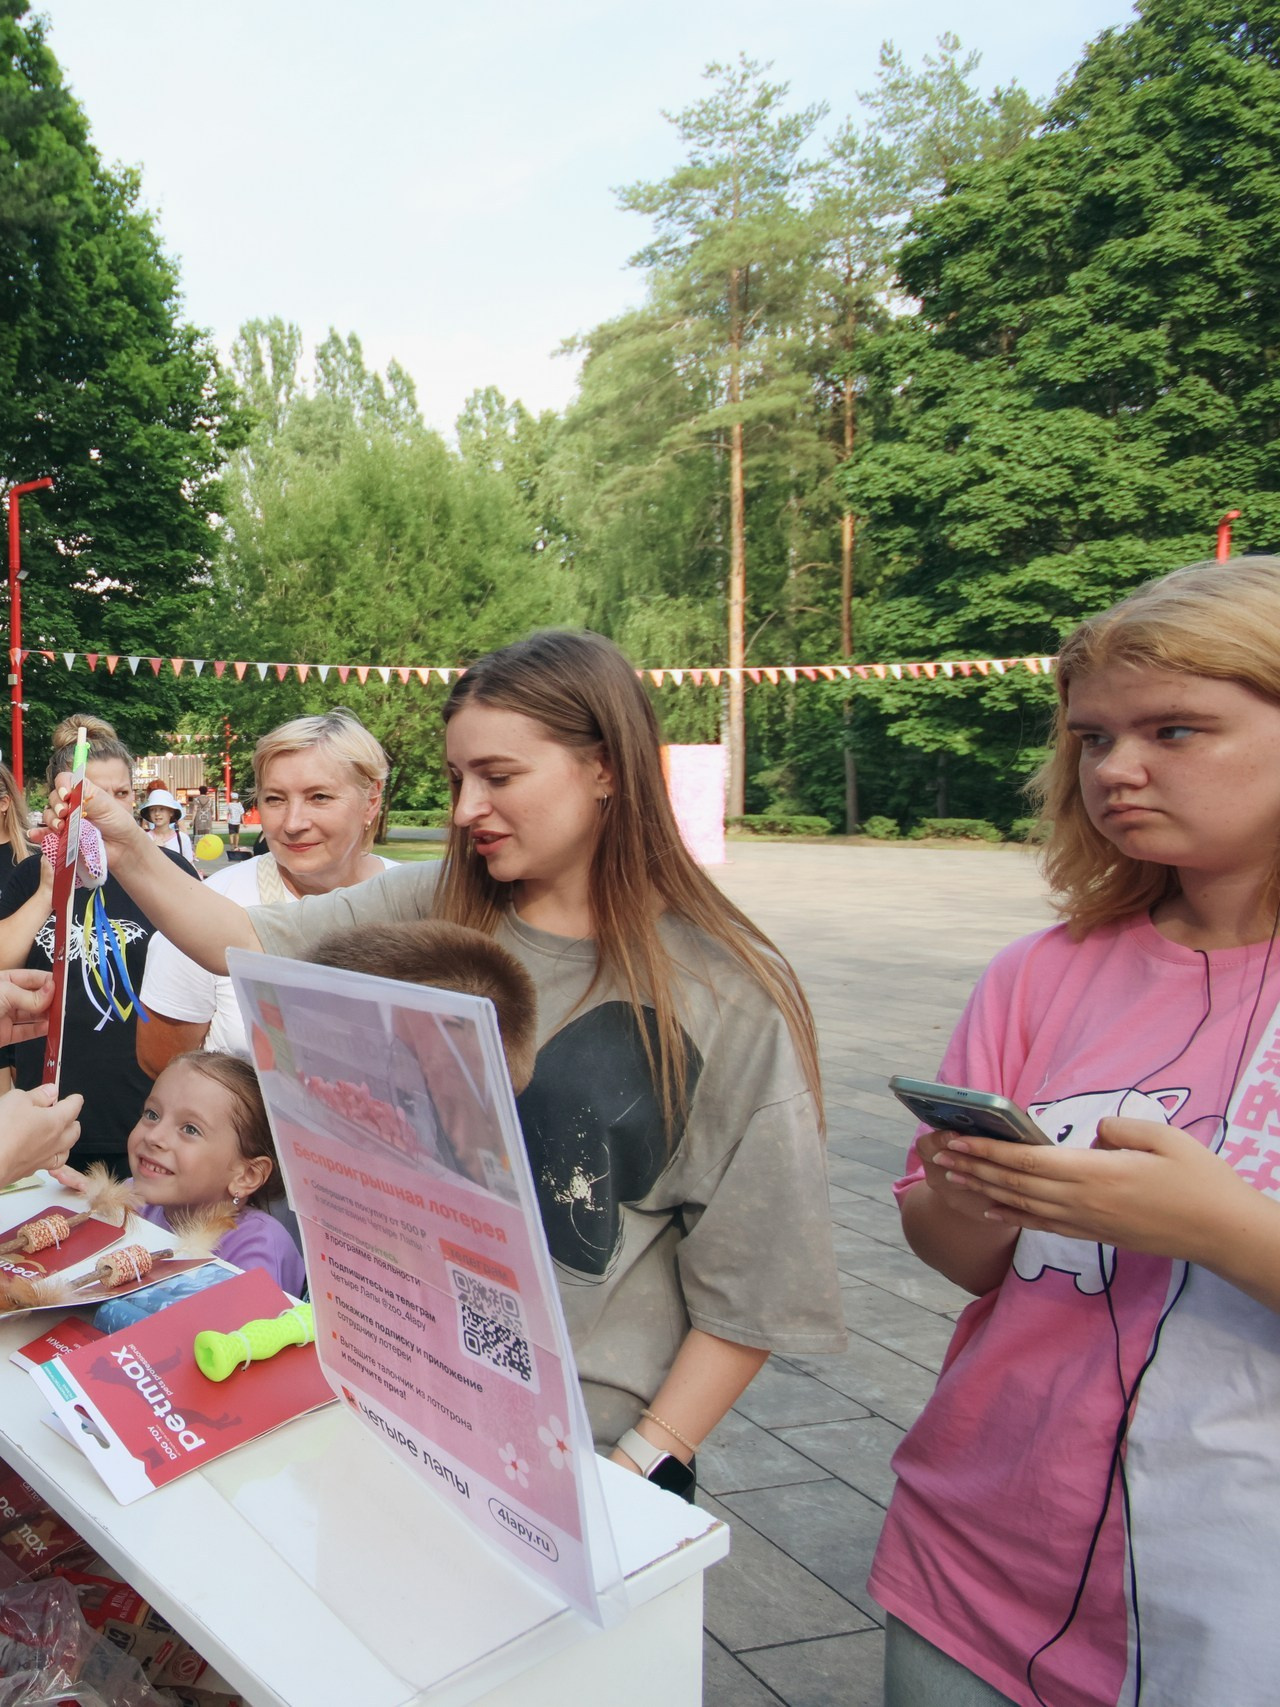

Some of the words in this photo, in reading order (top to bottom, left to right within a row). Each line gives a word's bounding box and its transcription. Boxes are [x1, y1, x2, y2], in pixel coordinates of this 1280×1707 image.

[293, 1141, 425, 1209] Беспроигрышная
[429, 1201, 508, 1244] лотерея
[310, 1179, 354, 1206] Совершите
[355, 1199, 388, 1223] покупку
[389, 1216, 399, 1226] от
[400, 1220, 419, 1236] 500
[368, 1215, 398, 1240] Четыре
[330, 1234, 372, 1262] программе
[373, 1255, 421, 1286] лояльности
[328, 1256, 383, 1292] Подпишитесь
[384, 1288, 394, 1298] на
[395, 1293, 436, 1323] телеграм
[330, 1271, 359, 1293] Четыре
[360, 1284, 381, 1307] Лапы
[382, 1298, 426, 1332] @zoo_4lapy
[129, 1343, 162, 1383] professional
[335, 1295, 374, 1324] Покажите
[375, 1319, 415, 1352] подписку
[423, 1350, 484, 1393] приложение
[337, 1311, 377, 1344] сотруднику
[379, 1338, 412, 1364] лотереи
[110, 1345, 206, 1452] petmax
[158, 1379, 173, 1396] pets
[340, 1335, 376, 1368] Вытащите
[377, 1360, 415, 1391] талончик
[416, 1387, 425, 1400] из
[427, 1394, 473, 1431] лототрона
[347, 1354, 383, 1385] получите
[384, 1379, 407, 1401] приз!
[147, 1425, 162, 1442] TOY
[160, 1441, 177, 1461] DOG
[358, 1402, 418, 1457] четыре
[423, 1450, 470, 1499] лапы
[497, 1508, 550, 1552] 4lapy.ru
